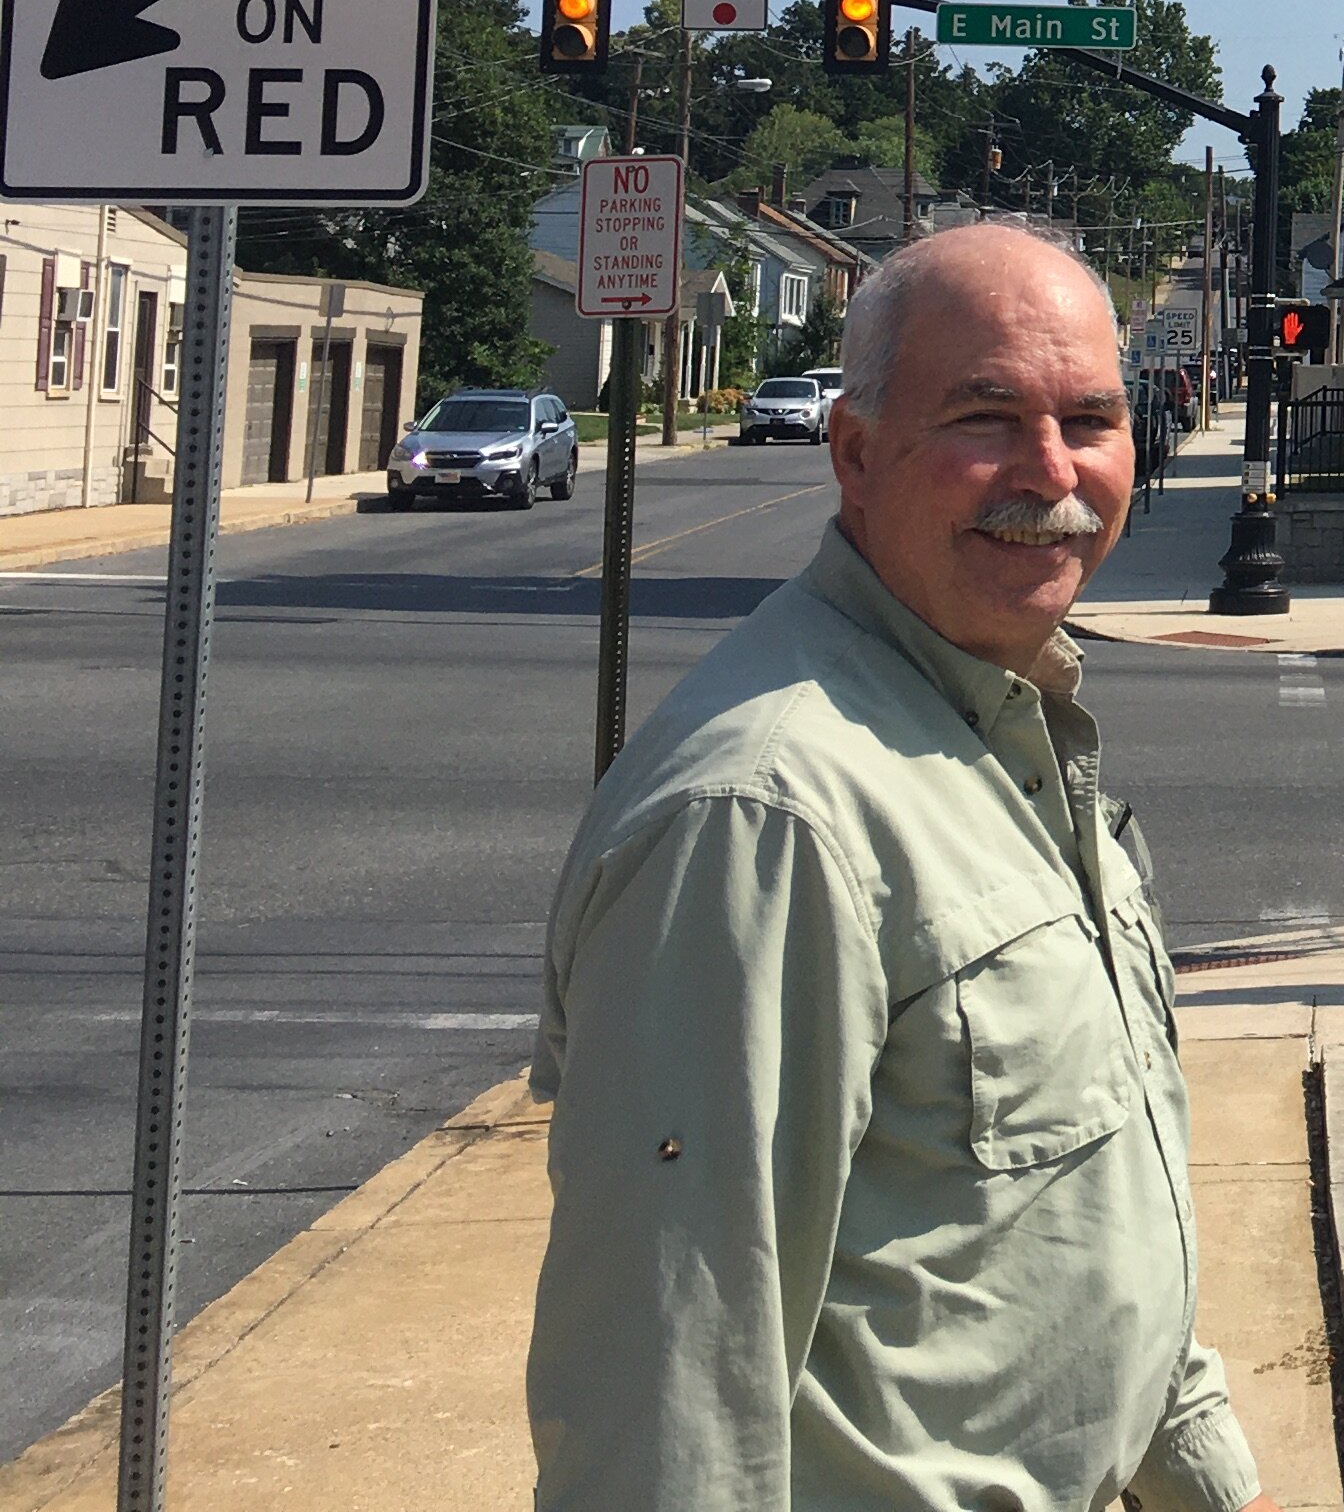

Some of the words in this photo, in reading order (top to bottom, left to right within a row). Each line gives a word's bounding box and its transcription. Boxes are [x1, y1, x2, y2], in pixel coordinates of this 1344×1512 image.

[952, 13, 967, 37] E
[991, 13, 1062, 39] Main
[1091, 17, 1120, 40] St
[160, 65, 386, 157] RED
[613, 165, 650, 195] NO
[599, 197, 662, 214] PARKING
[595, 216, 665, 233] STOPPING
[619, 235, 639, 251] OR
[593, 254, 663, 271] STANDING
[597, 273, 659, 289] ANYTIME
[1165, 312, 1195, 320] SPEED
[1166, 329, 1193, 345] 25
